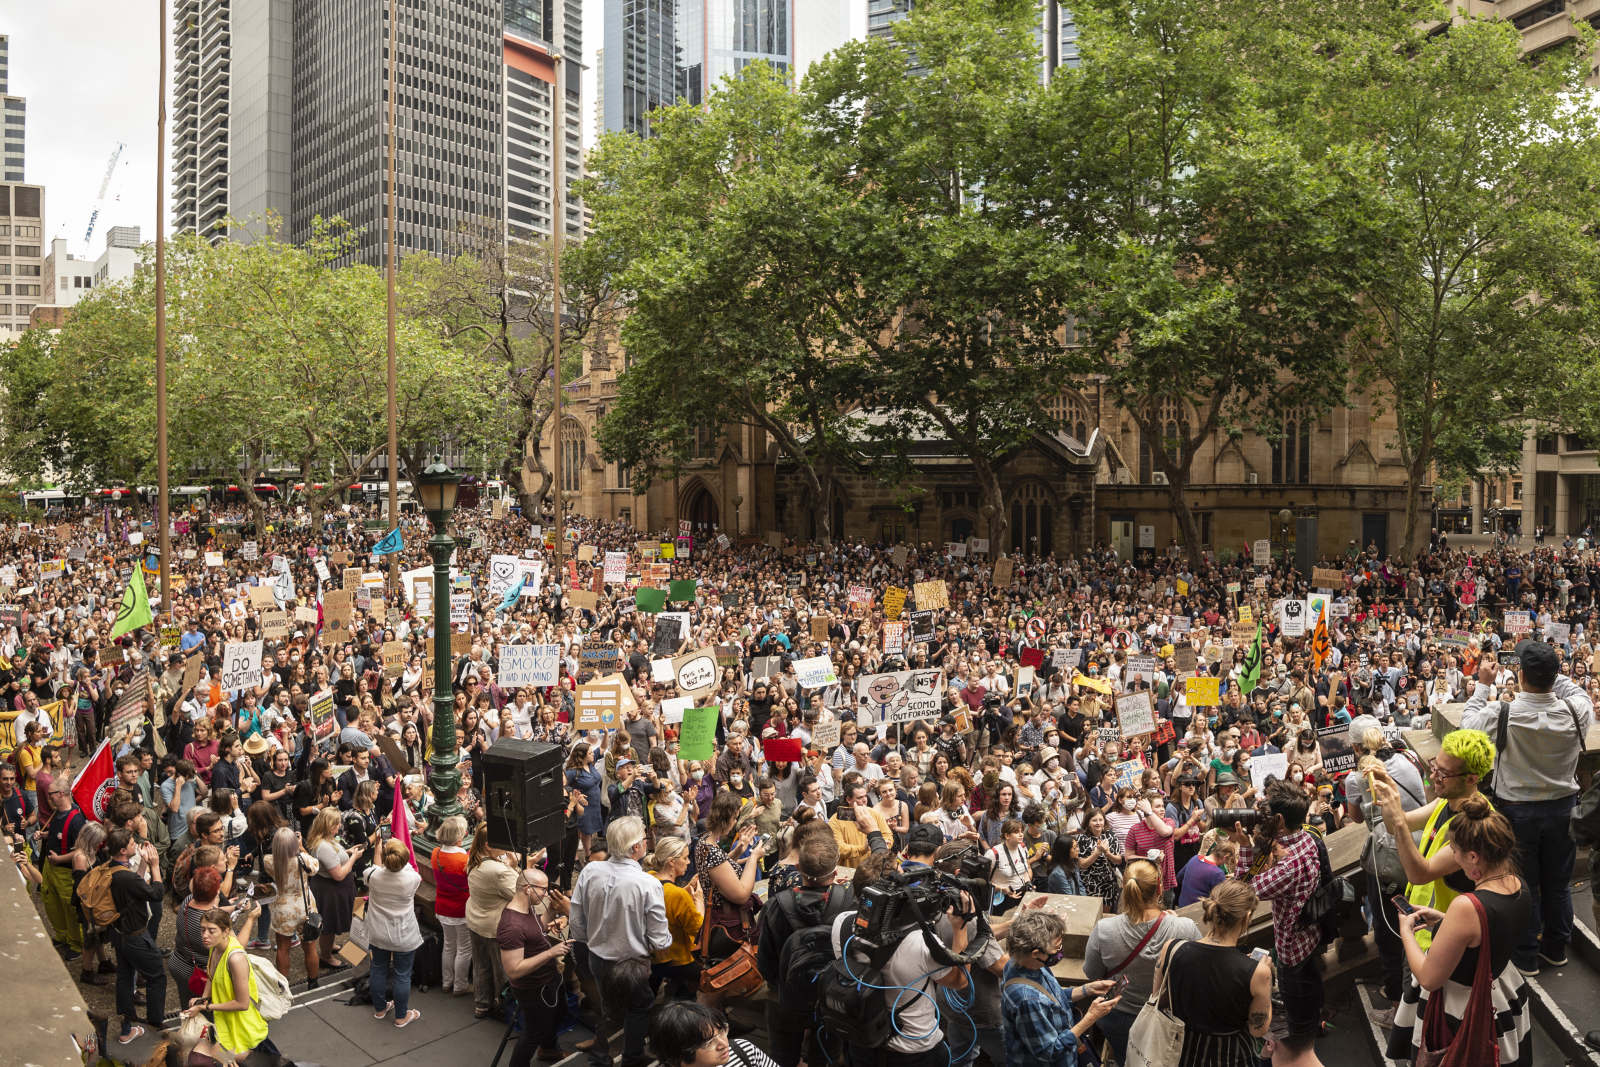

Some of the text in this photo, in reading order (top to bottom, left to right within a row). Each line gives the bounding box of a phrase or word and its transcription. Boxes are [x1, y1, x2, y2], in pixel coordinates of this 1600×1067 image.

[911, 611, 931, 619] SCOMO
[263, 617, 286, 628] WORRIED
[503, 645, 559, 657] THIS IS NOT THE
[231, 657, 250, 673] DO
[500, 657, 554, 672] SMOKO
[221, 669, 261, 691] SOMETHING
[521, 672, 532, 682] IN
[533, 671, 553, 682] MIND
[681, 671, 695, 679] THIS
[916, 676, 936, 687] NSW
[907, 700, 936, 711] SCOMO
[892, 712, 908, 722] OUT
[1324, 754, 1355, 768] MY VIEW
